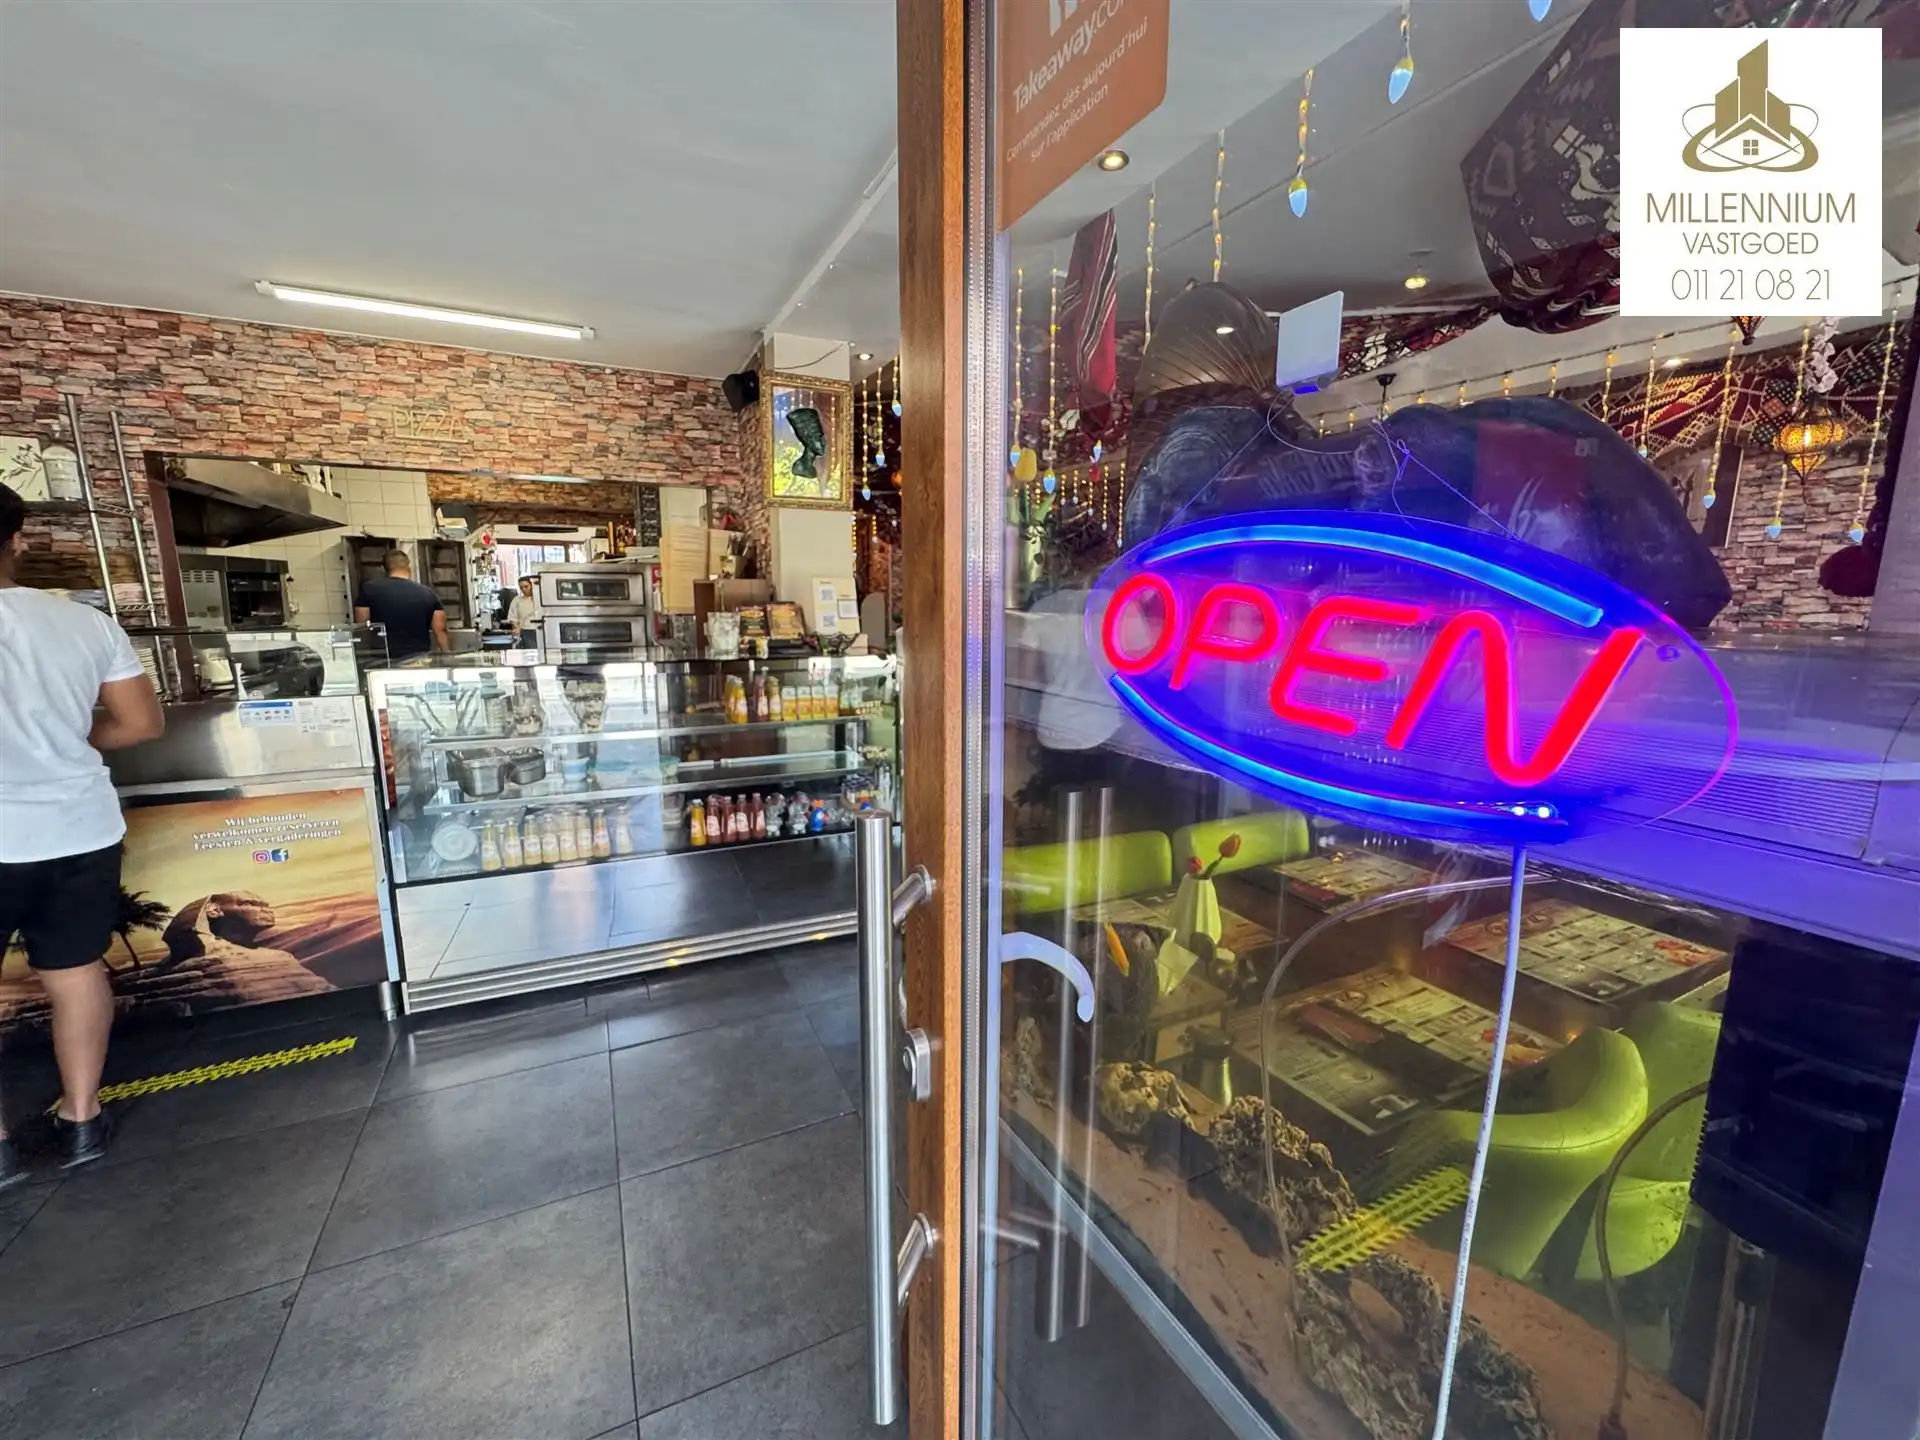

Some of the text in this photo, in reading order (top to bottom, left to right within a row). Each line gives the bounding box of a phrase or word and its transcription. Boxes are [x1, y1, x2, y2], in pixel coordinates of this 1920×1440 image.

[1006, 15, 1149, 163] Commandez dès aujourd'hui
[1013, 0, 1124, 114] Takeaway.co
[1030, 83, 1109, 163] sur l'application
[392, 408, 468, 443] PIZZA
[1101, 571, 1647, 787] OPEN
[225, 817, 245, 828] Wij
